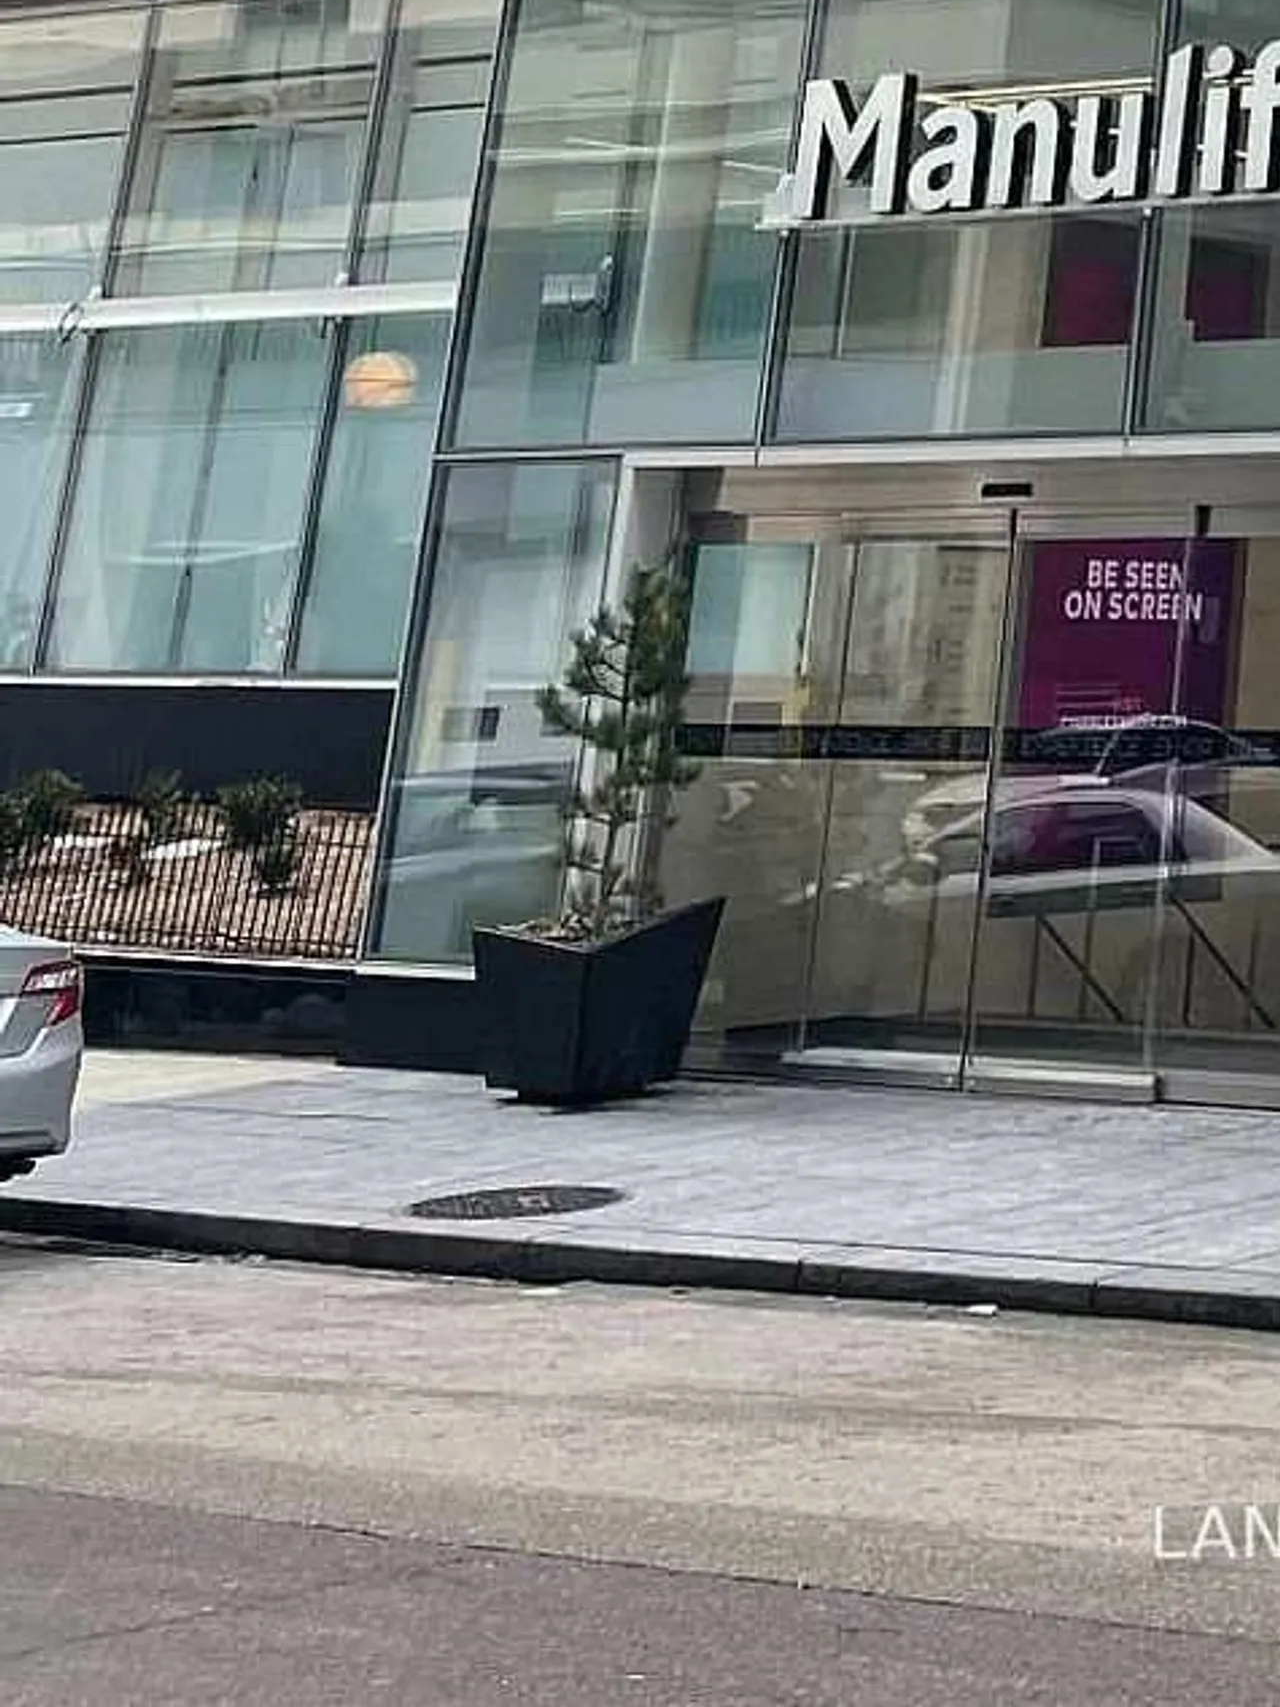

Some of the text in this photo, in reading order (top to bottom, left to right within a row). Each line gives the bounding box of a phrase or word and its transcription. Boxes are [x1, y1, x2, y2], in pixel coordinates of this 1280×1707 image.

[1087, 559, 1185, 589] BE SEEN
[1064, 590, 1203, 621] ON SCREEN
